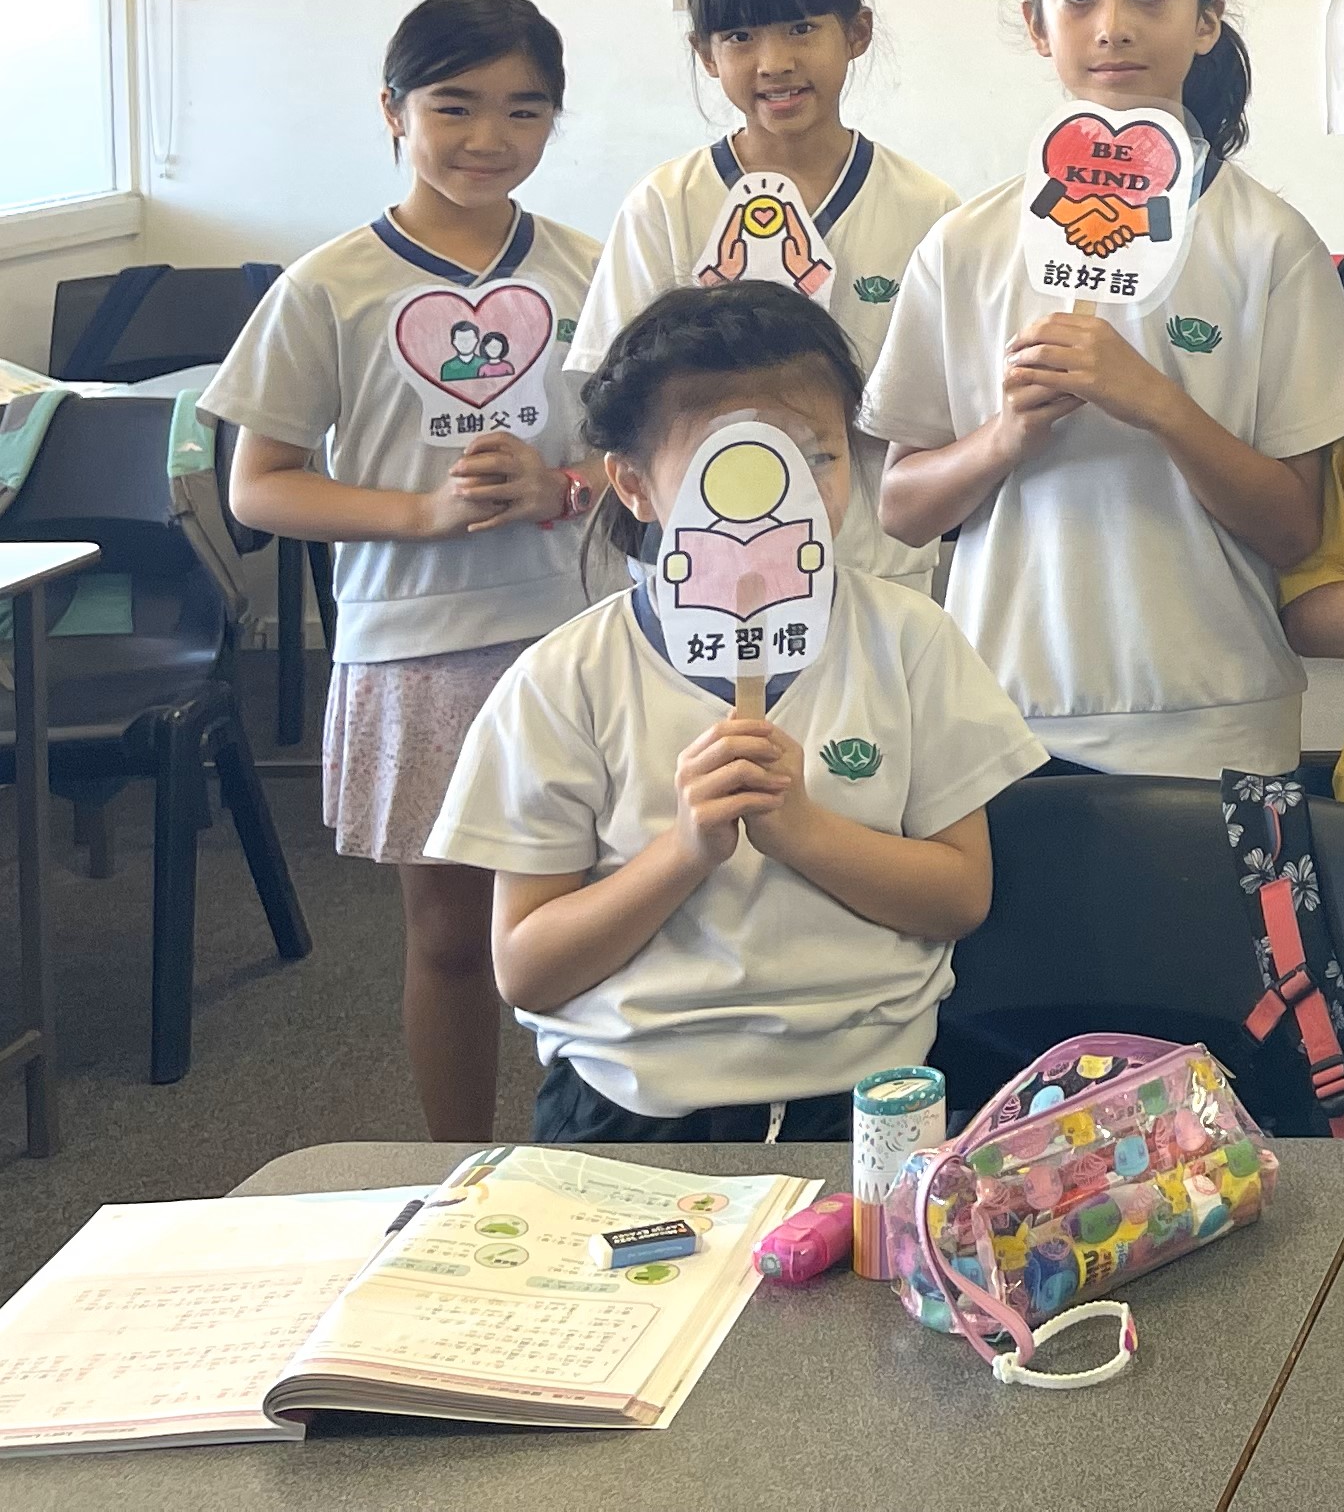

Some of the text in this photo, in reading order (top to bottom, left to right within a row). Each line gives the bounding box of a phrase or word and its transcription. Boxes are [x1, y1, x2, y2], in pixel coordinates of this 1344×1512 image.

[1091, 141, 1133, 163] BE
[1065, 165, 1151, 191] KIND
[1043, 260, 1139, 296] 說好話
[430, 405, 540, 437] 感謝父母
[687, 622, 809, 664] 好習慣
